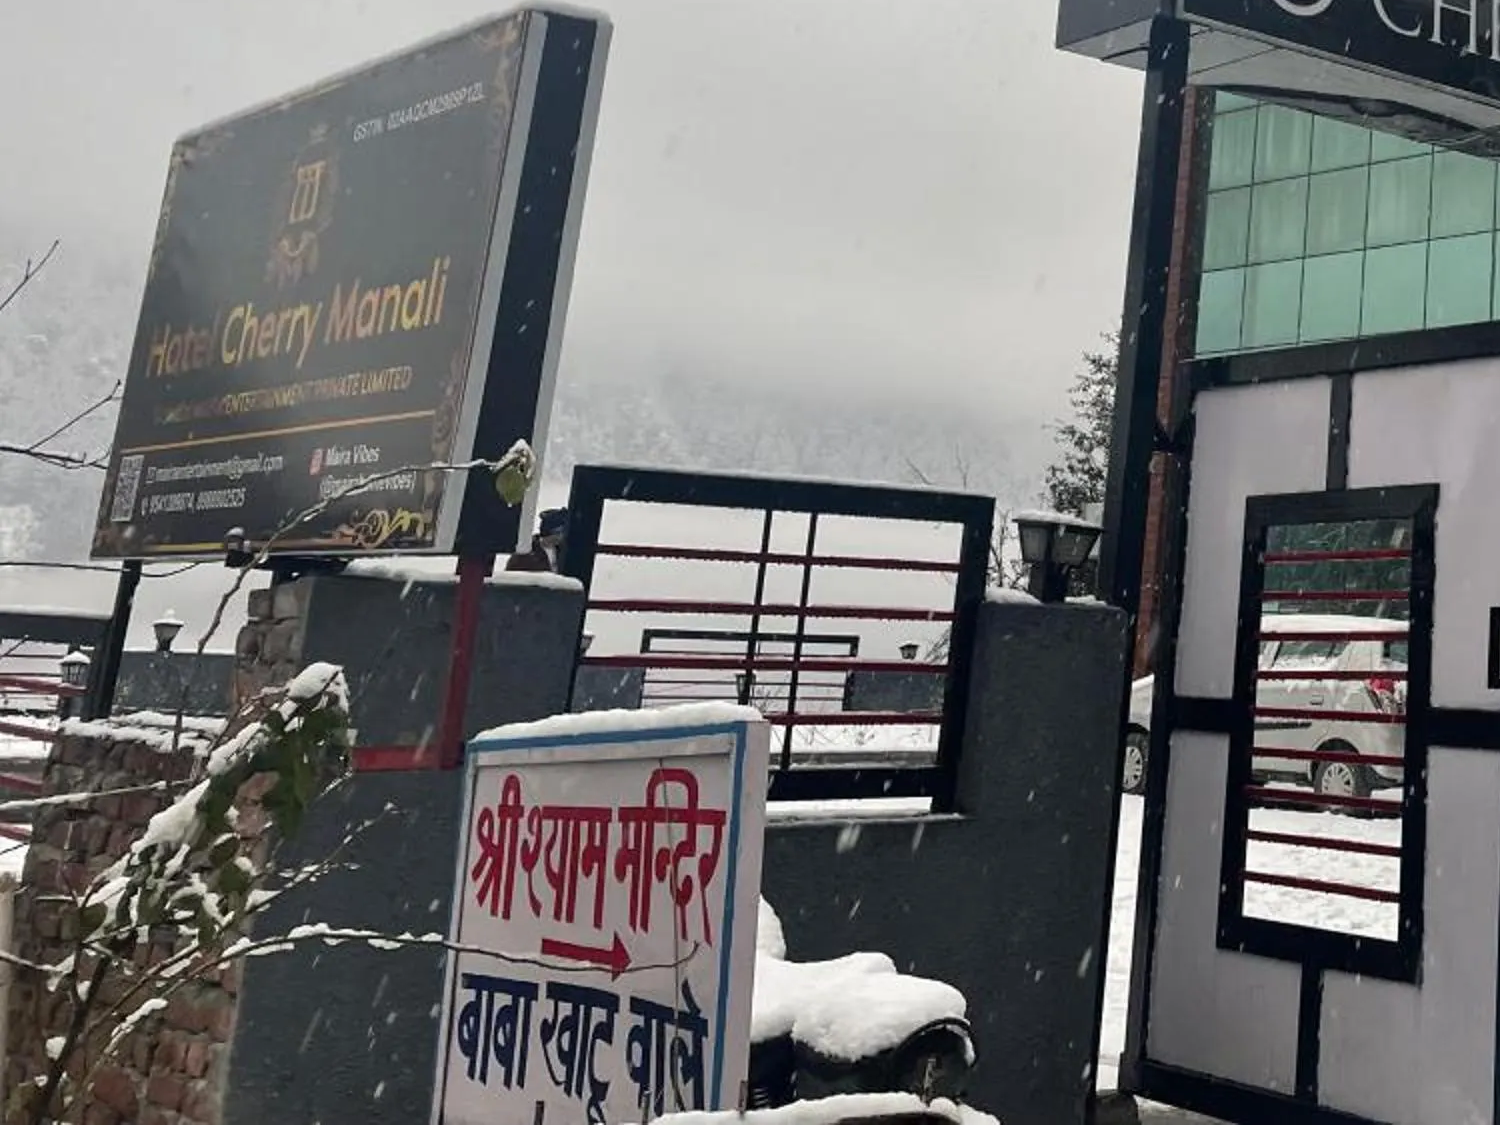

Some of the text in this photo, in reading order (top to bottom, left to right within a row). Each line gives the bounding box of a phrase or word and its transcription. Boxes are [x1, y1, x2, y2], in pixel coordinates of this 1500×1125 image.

[146, 255, 450, 377] Hotel Cherry Manali
[361, 365, 414, 395] LIMITED
[472, 768, 727, 948] श्री श्याम मन्दिर
[458, 972, 539, 1091] बाबा
[626, 977, 709, 1118] वाले
